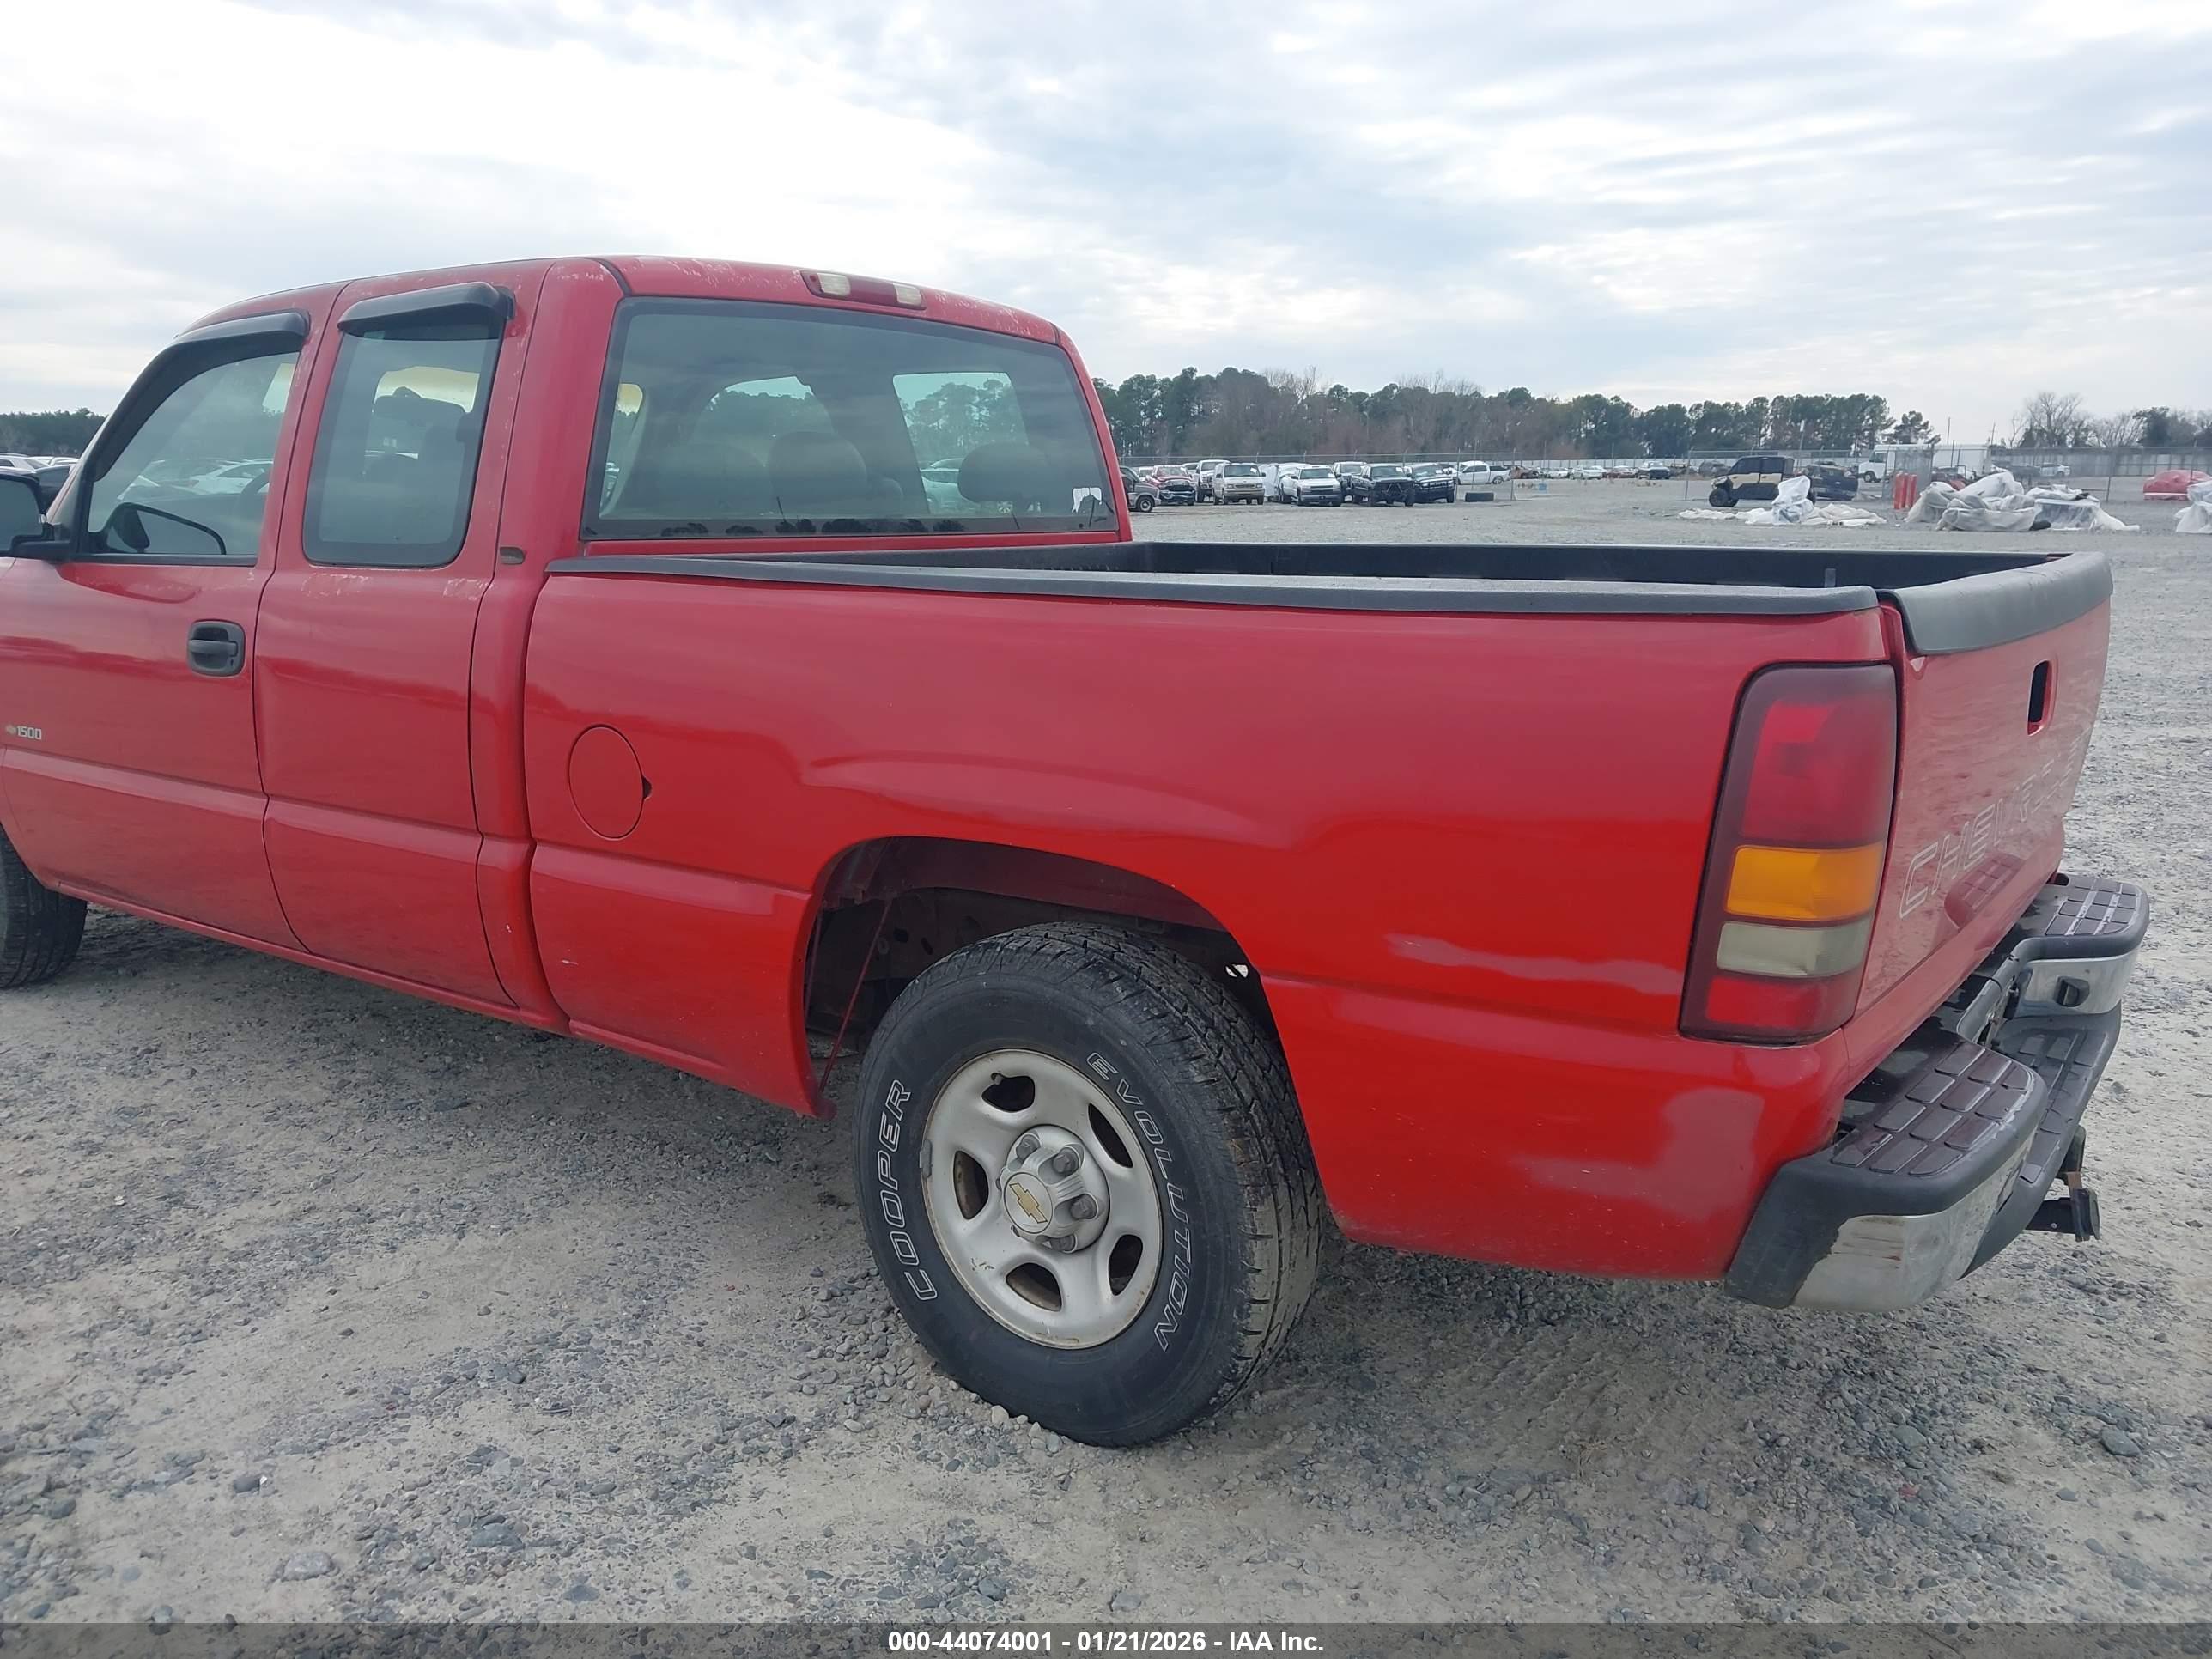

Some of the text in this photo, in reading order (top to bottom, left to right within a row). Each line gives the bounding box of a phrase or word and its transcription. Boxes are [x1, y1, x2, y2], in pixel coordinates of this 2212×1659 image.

[17, 726, 42, 740] 1500
[1899, 727, 2093, 919] CHEVROE
[877, 1079, 938, 1301] COOPER
[1086, 1052, 1192, 1352] EVOLUTION
